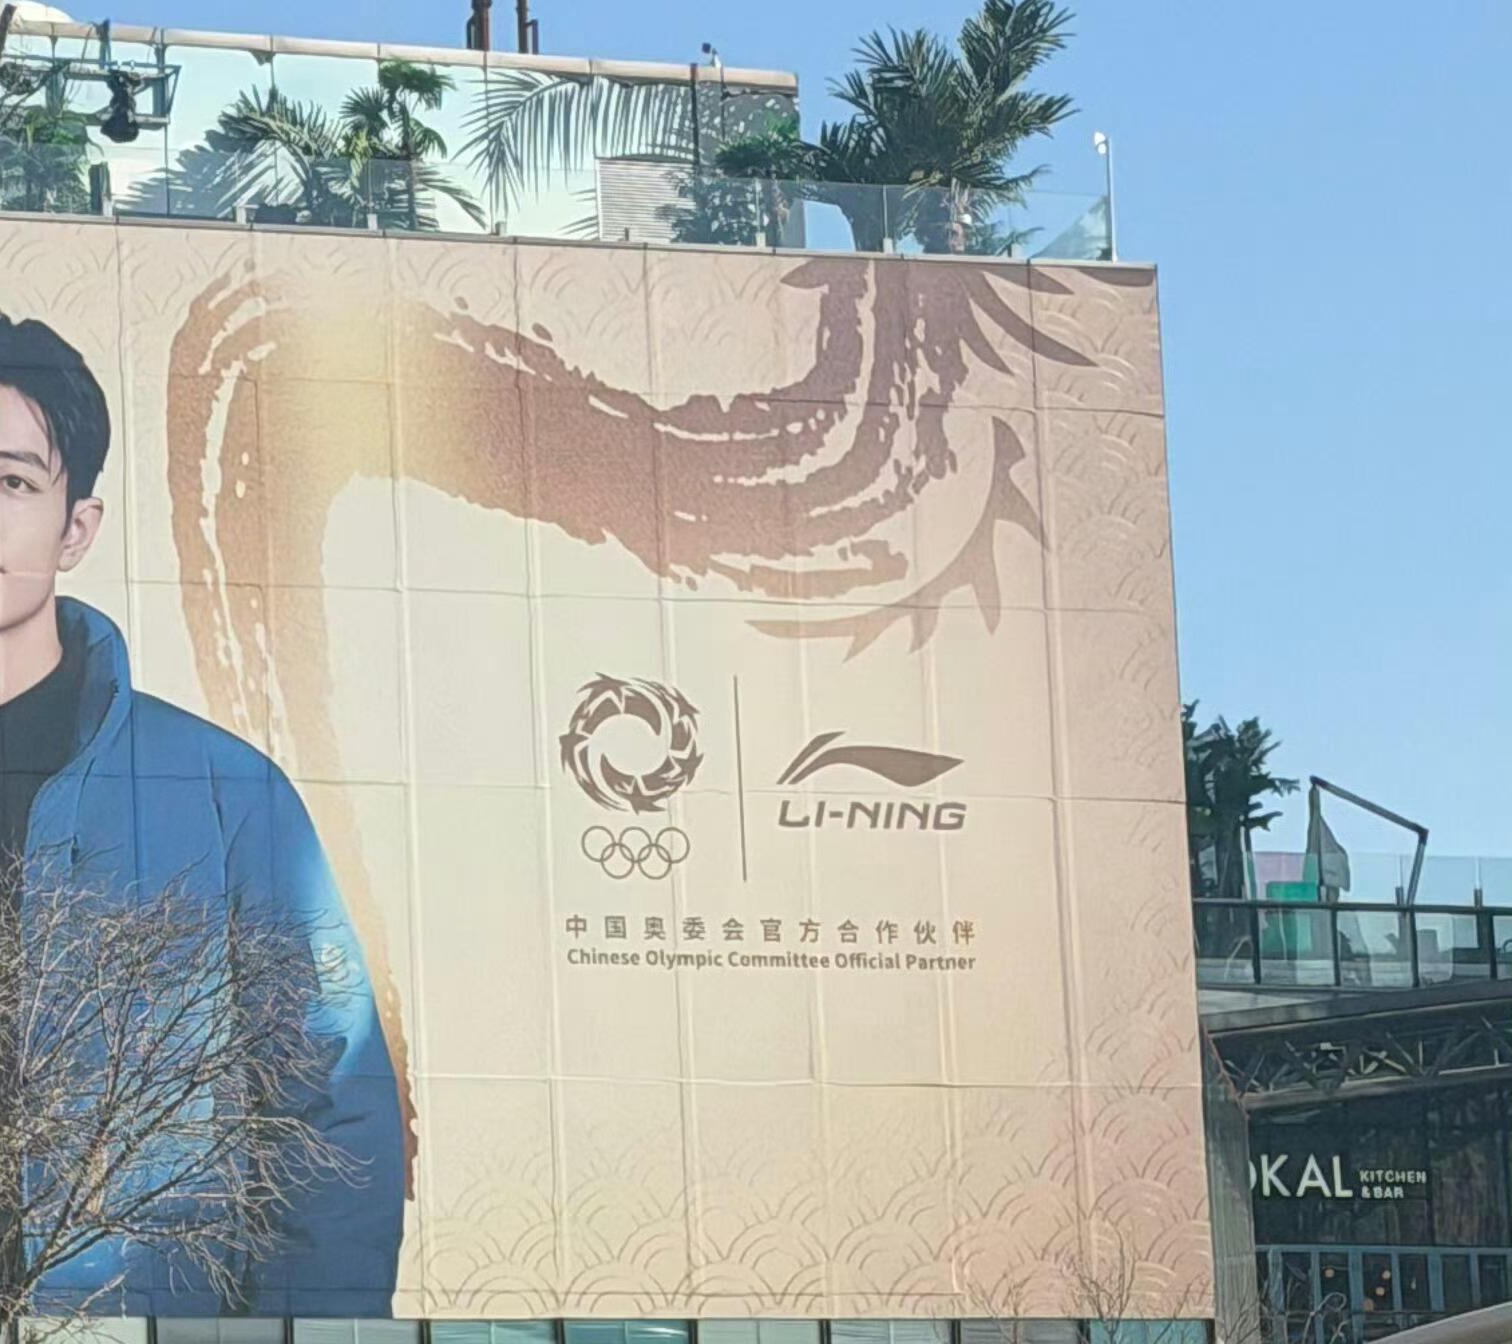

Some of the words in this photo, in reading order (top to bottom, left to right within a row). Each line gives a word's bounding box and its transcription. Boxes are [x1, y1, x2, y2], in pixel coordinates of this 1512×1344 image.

[778, 799, 967, 830] LI-NING
[565, 915, 976, 946] 中国奥委会官方合作伙伴
[566, 948, 641, 967] Chinese
[645, 949, 723, 970] Olympic
[728, 951, 830, 970] Committee
[834, 952, 901, 970] Official
[905, 953, 976, 970] Partner
[1360, 1170, 1427, 1183] KITCHEN
[1373, 1186, 1404, 1198] BAR
